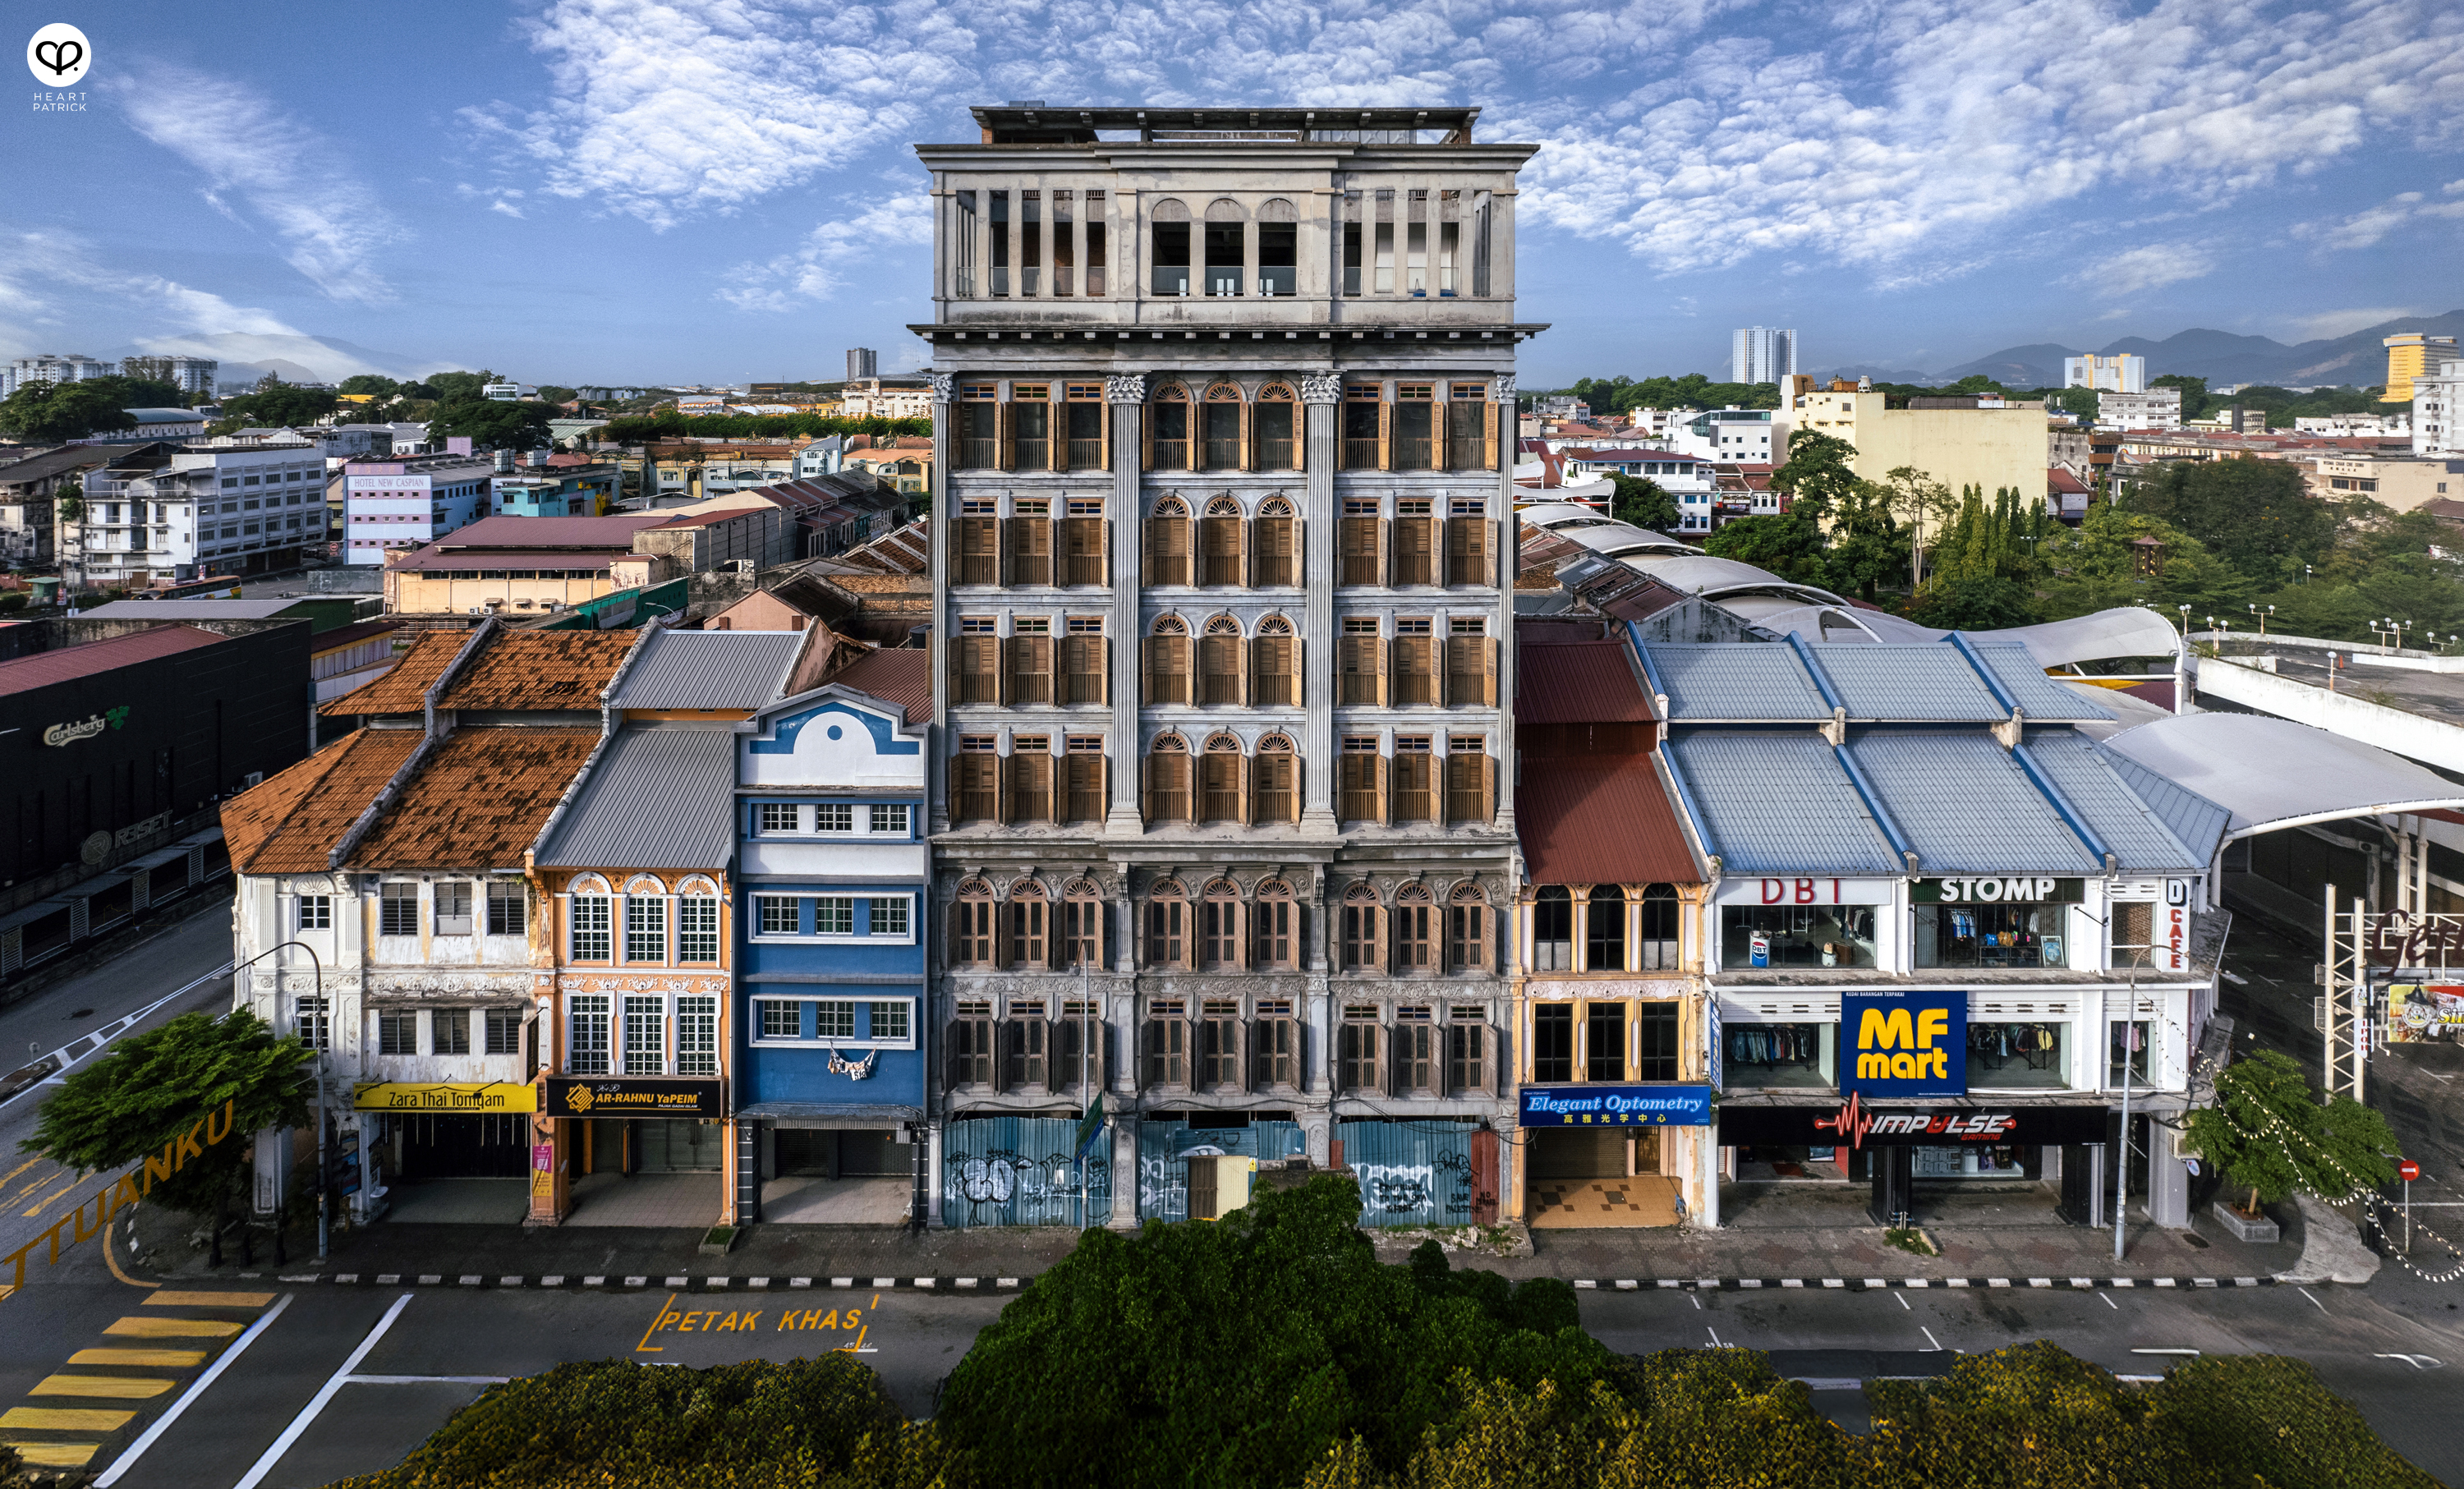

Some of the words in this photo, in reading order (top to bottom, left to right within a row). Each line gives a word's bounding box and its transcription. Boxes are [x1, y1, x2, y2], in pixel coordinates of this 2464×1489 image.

[354, 478, 375, 487] HOTEL
[378, 478, 393, 487] NEW
[396, 478, 424, 487] CASPIAN
[44, 716, 106, 747] Carlsberg
[1762, 878, 1846, 904] DBT
[1940, 877, 2056, 902] STOMP
[2167, 878, 2187, 907] D
[1752, 944, 1767, 953] DBT
[2168, 908, 2184, 969] CAFE
[1857, 1008, 1949, 1050] MF
[1857, 1047, 1948, 1079] mart
[388, 1091, 417, 1107] Zara
[421, 1091, 448, 1107] Thai
[451, 1091, 505, 1110] Tomyam
[595, 1093, 655, 1104] AR-RAHNU
[657, 1093, 698, 1104] YaPEIM
[1528, 1096, 1602, 1113] Elegant
[1605, 1095, 1703, 1113] Optometry
[1869, 1114, 2012, 1134] IMPULSE
[658, 1310, 763, 1331] PETAK
[778, 1308, 862, 1330] KHAS
